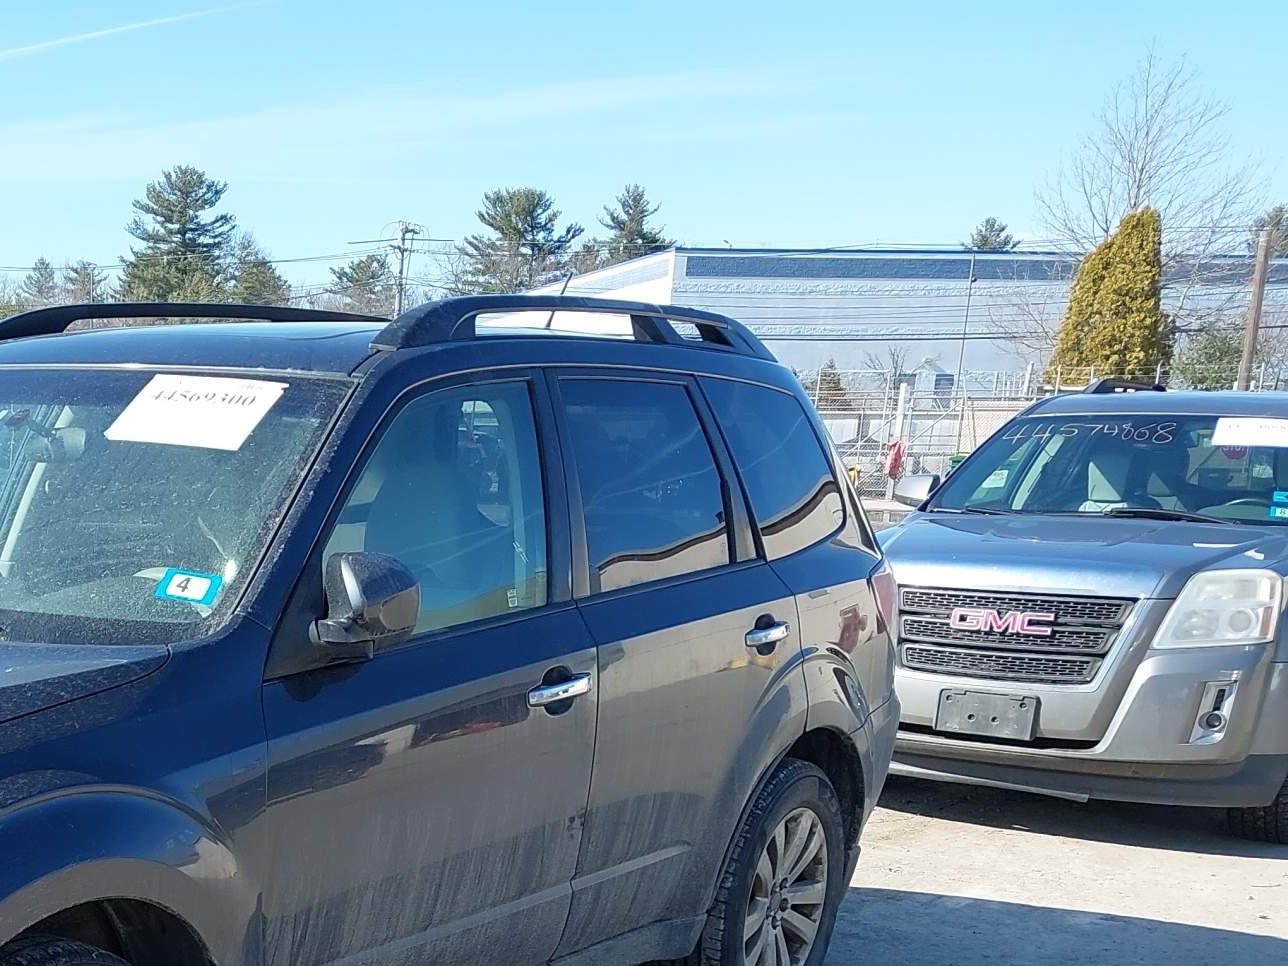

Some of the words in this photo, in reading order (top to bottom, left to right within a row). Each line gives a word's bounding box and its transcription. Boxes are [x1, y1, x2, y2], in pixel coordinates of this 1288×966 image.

[1002, 422, 1177, 445] 44574868
[175, 577, 192, 593] 4
[950, 607, 1055, 636] GMC
